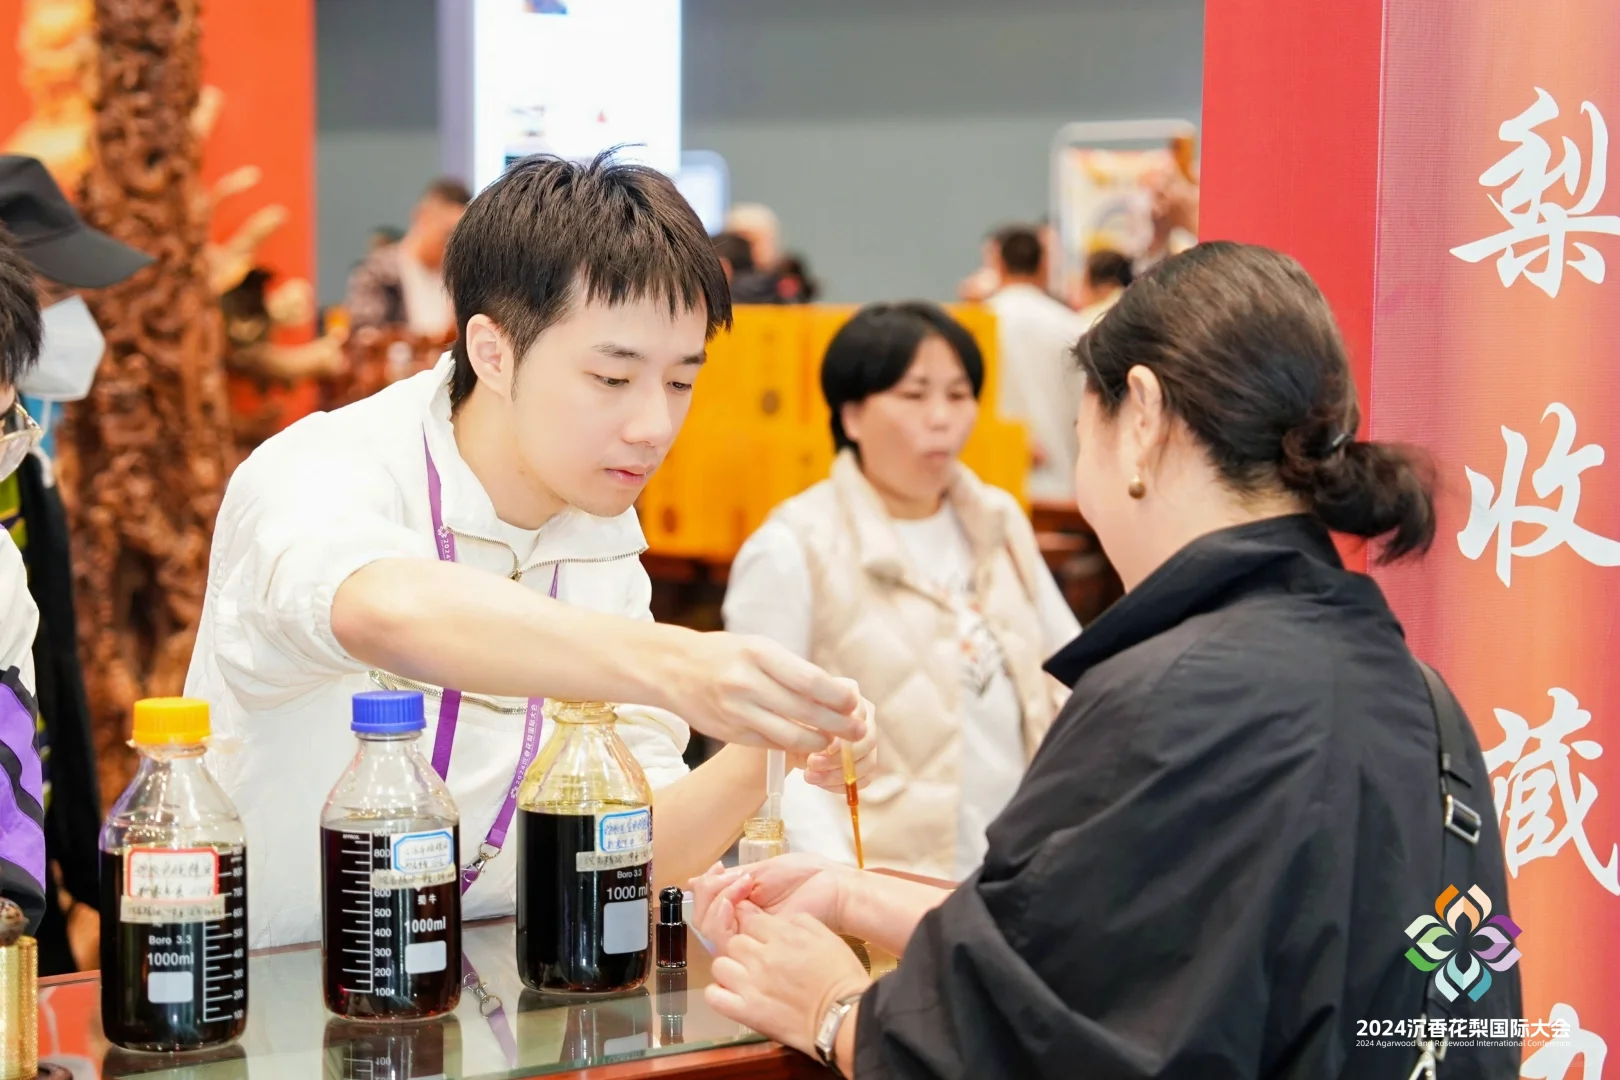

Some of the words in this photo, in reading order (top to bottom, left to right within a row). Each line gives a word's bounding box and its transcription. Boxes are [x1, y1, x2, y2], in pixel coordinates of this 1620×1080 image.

[373, 848, 391, 858] 800
[617, 871, 633, 879] Boro
[633, 868, 643, 877] 3.3
[374, 888, 391, 898] 600
[606, 885, 636, 900] 1000
[638, 882, 648, 896] ml
[374, 908, 391, 917] 500
[404, 916, 446, 933] 1000ml
[374, 928, 392, 937] 400
[148, 935, 172, 945] Boro
[176, 934, 192, 944] 3.3
[374, 948, 392, 957] 300
[147, 952, 194, 966] 1000ml
[374, 967, 391, 977] 200
[375, 988, 392, 997] 100
